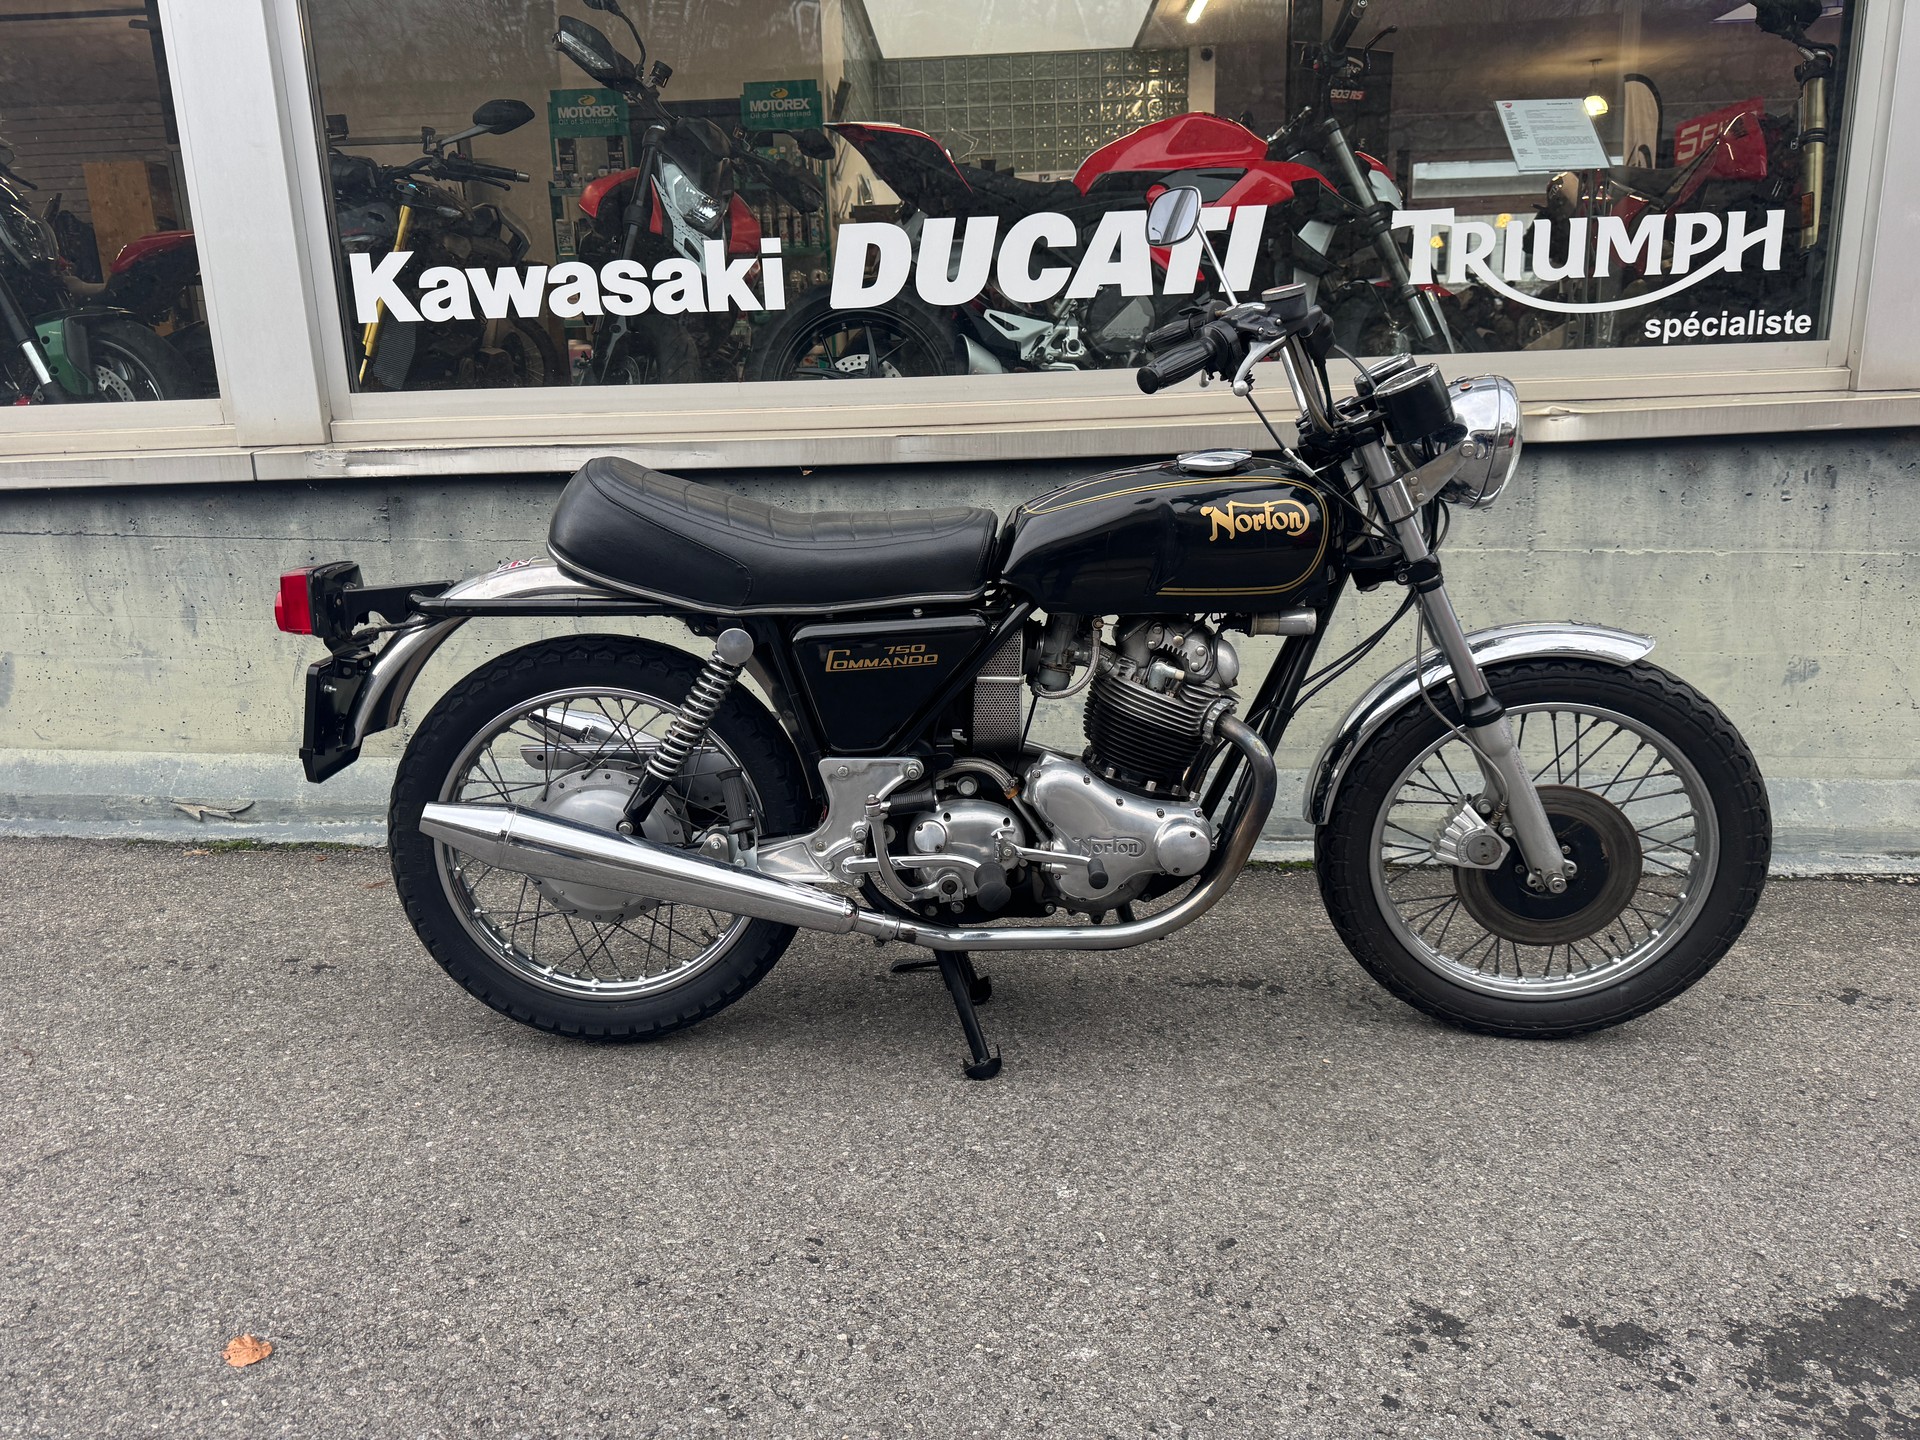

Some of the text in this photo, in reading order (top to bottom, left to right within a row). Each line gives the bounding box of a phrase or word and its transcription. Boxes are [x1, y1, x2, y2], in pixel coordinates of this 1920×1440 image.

[557, 105, 618, 119] MOTOREX
[749, 98, 810, 112] MOTOREX
[771, 109, 812, 118] Switzerland
[830, 204, 1268, 310] DUCATI
[1391, 207, 1784, 313] TRIUMPH
[350, 237, 786, 324] Kawasaki
[1644, 308, 1813, 344] spécialiste
[1200, 500, 1310, 542] Norton
[825, 649, 938, 672] COMMANDO
[884, 644, 926, 655] 750
[1072, 835, 1147, 858] Norton
